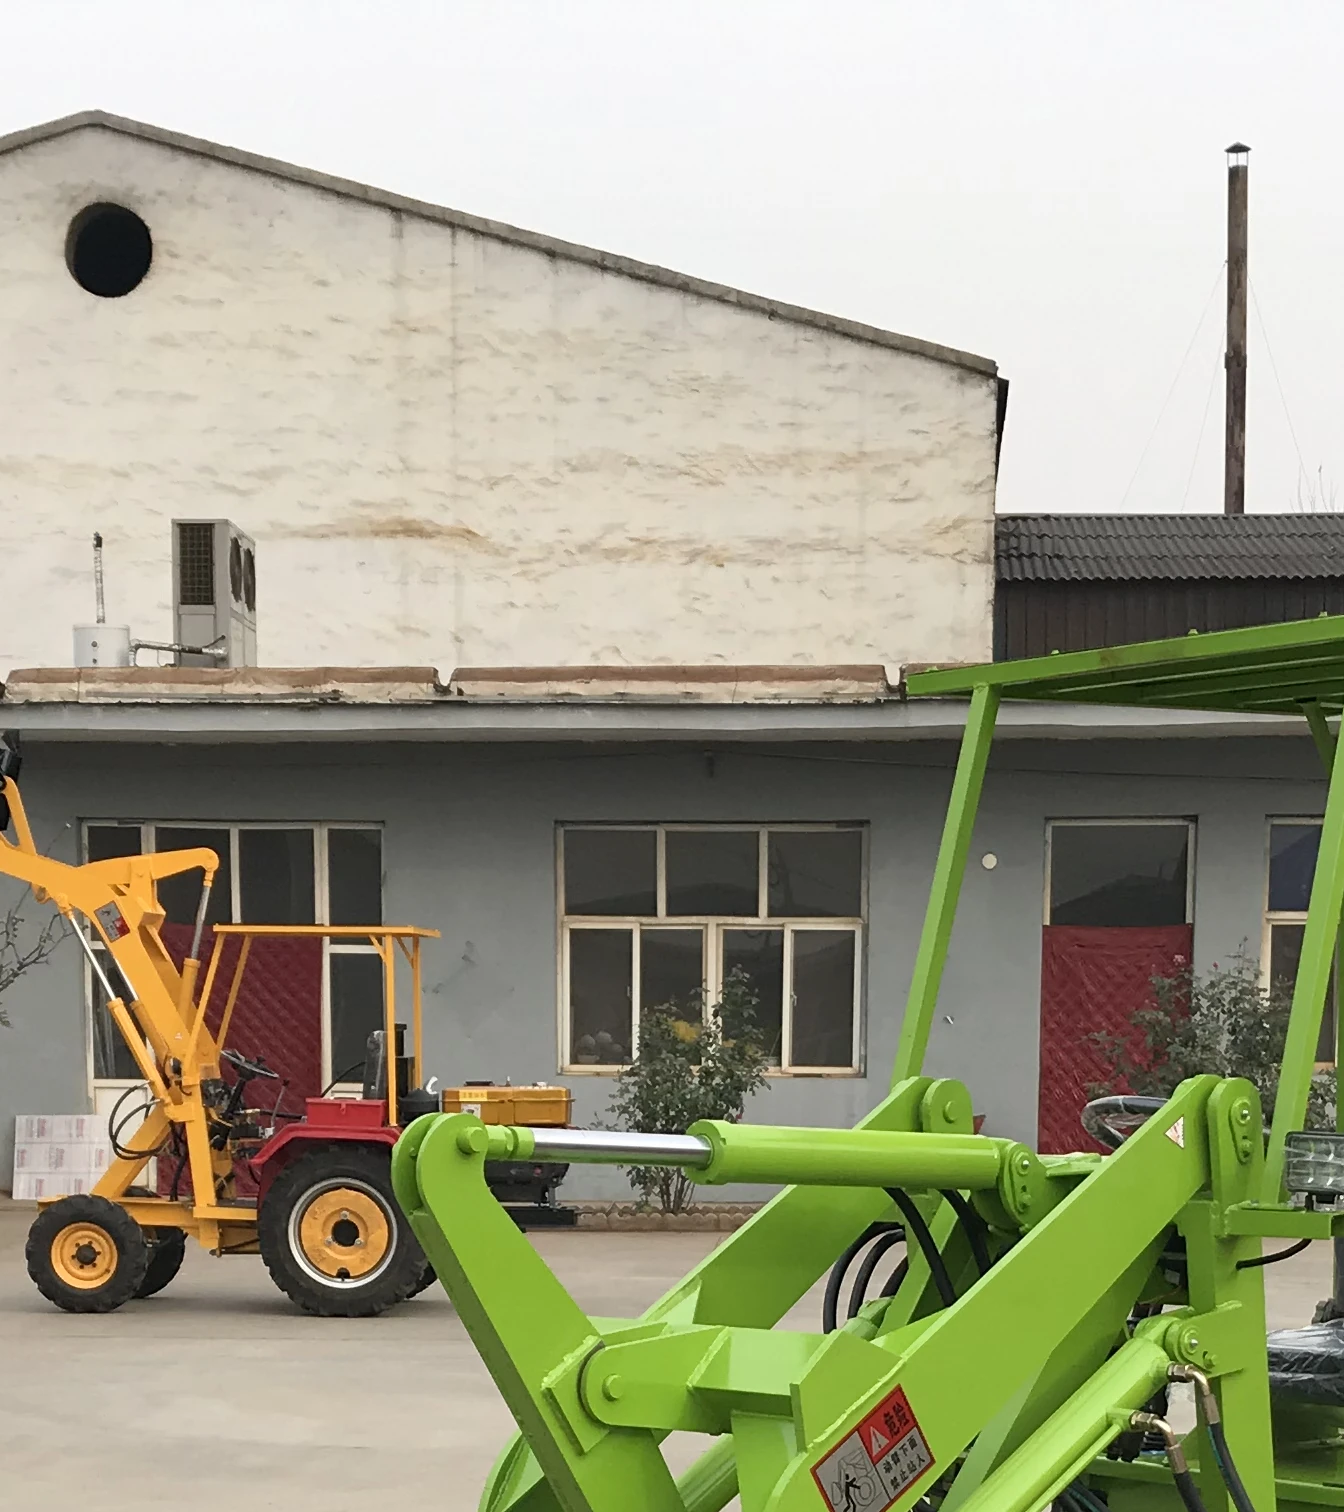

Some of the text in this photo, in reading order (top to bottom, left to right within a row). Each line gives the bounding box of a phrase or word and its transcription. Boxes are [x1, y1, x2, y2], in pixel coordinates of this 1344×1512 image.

[883, 1401, 910, 1437] 危险
[890, 1453, 926, 1491] 禁止站人
